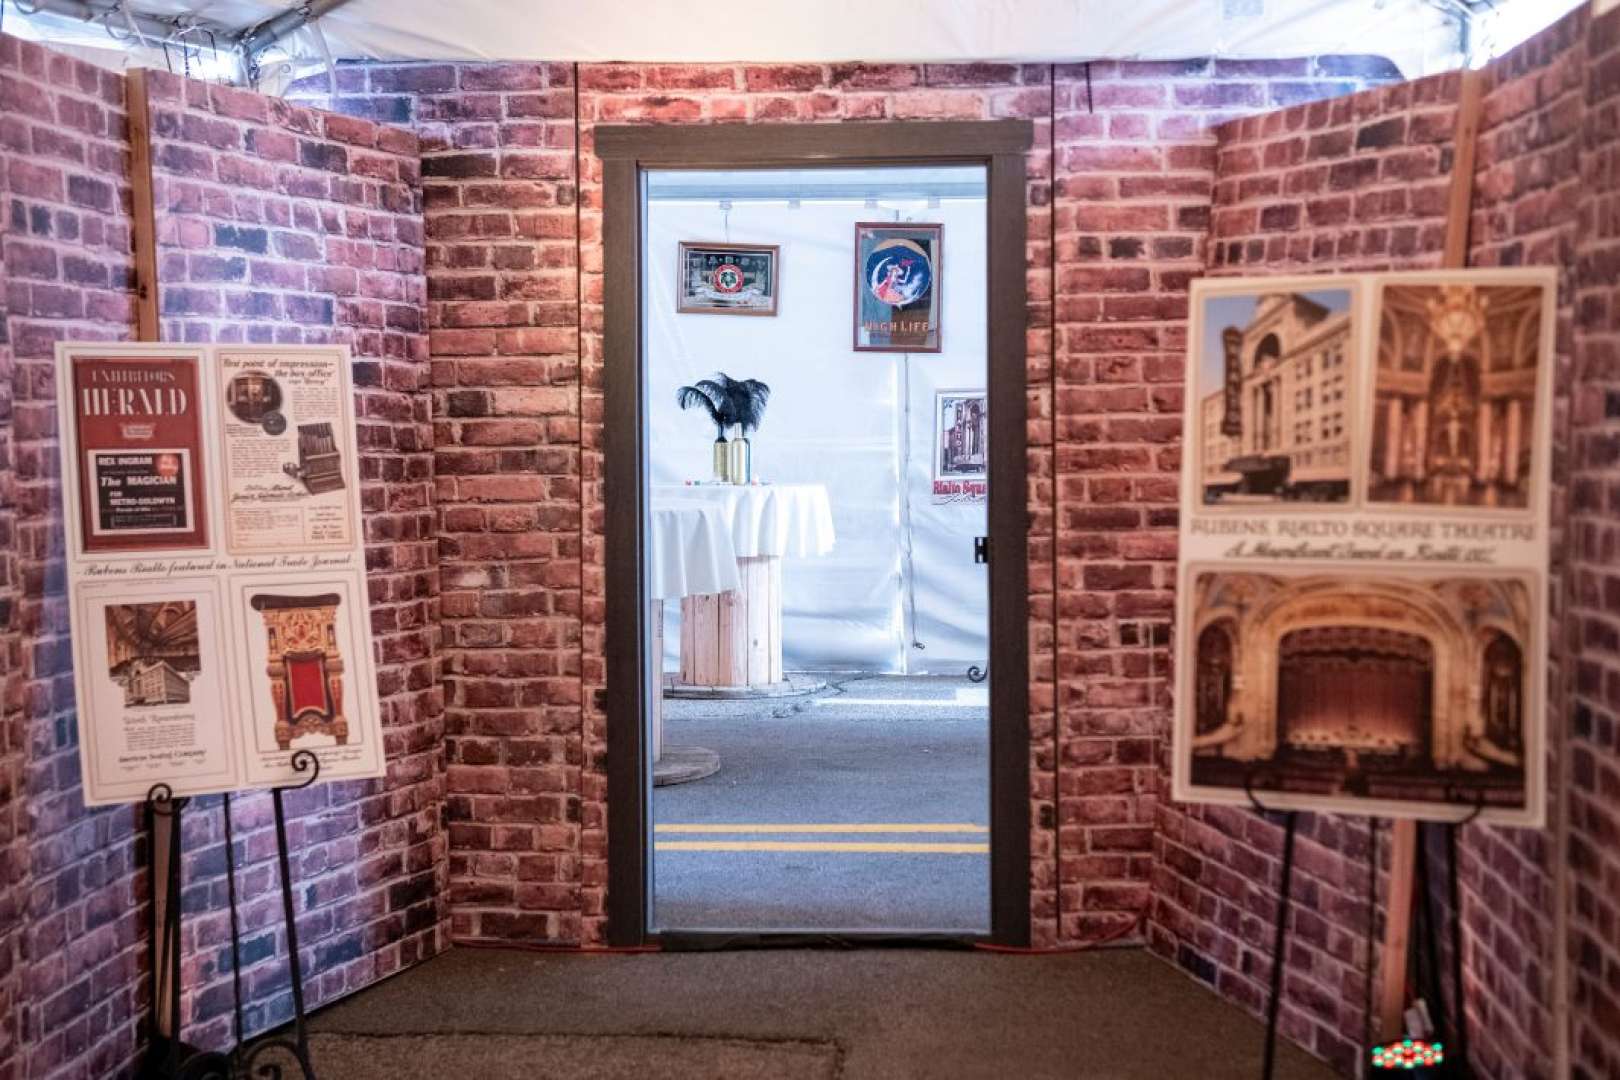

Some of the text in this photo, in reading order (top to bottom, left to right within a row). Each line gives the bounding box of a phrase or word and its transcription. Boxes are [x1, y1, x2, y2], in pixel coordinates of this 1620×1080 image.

[864, 320, 929, 334] HIGH LIFE
[82, 387, 188, 416] HERALD
[101, 475, 177, 487] The MAGICIAN
[933, 480, 961, 494] Rialto
[1190, 519, 1269, 536] RUBENS
[1278, 519, 1349, 538] RIALTO
[1352, 520, 1433, 539] SQUARE
